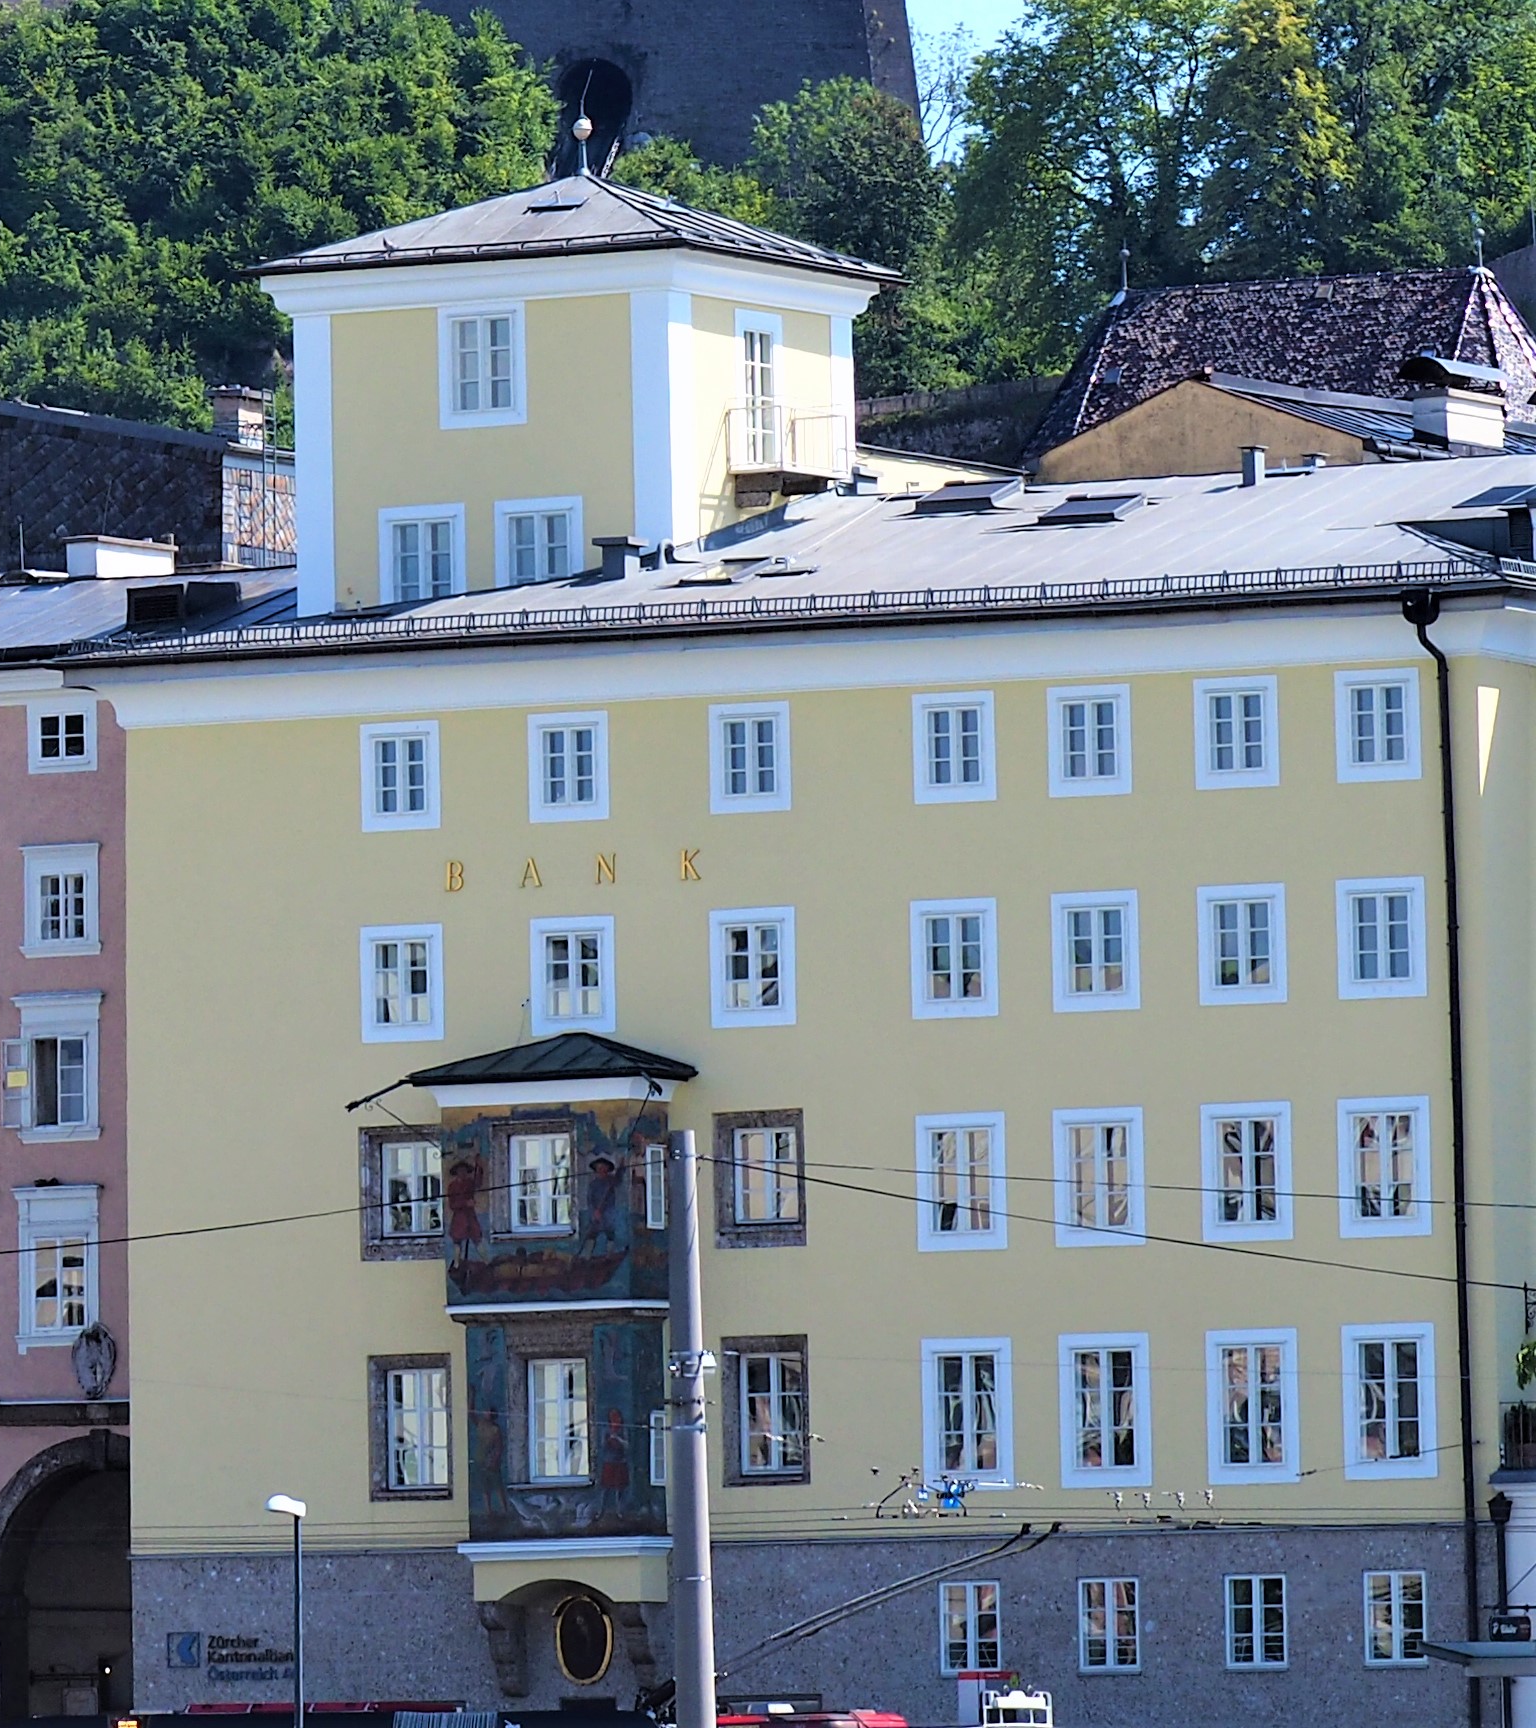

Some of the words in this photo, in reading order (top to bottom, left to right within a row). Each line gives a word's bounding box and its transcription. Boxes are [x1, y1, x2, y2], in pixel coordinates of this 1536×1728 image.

[445, 849, 701, 892] BANK
[208, 1634, 260, 1649] Zürcher
[208, 1649, 294, 1663] Kantonalban
